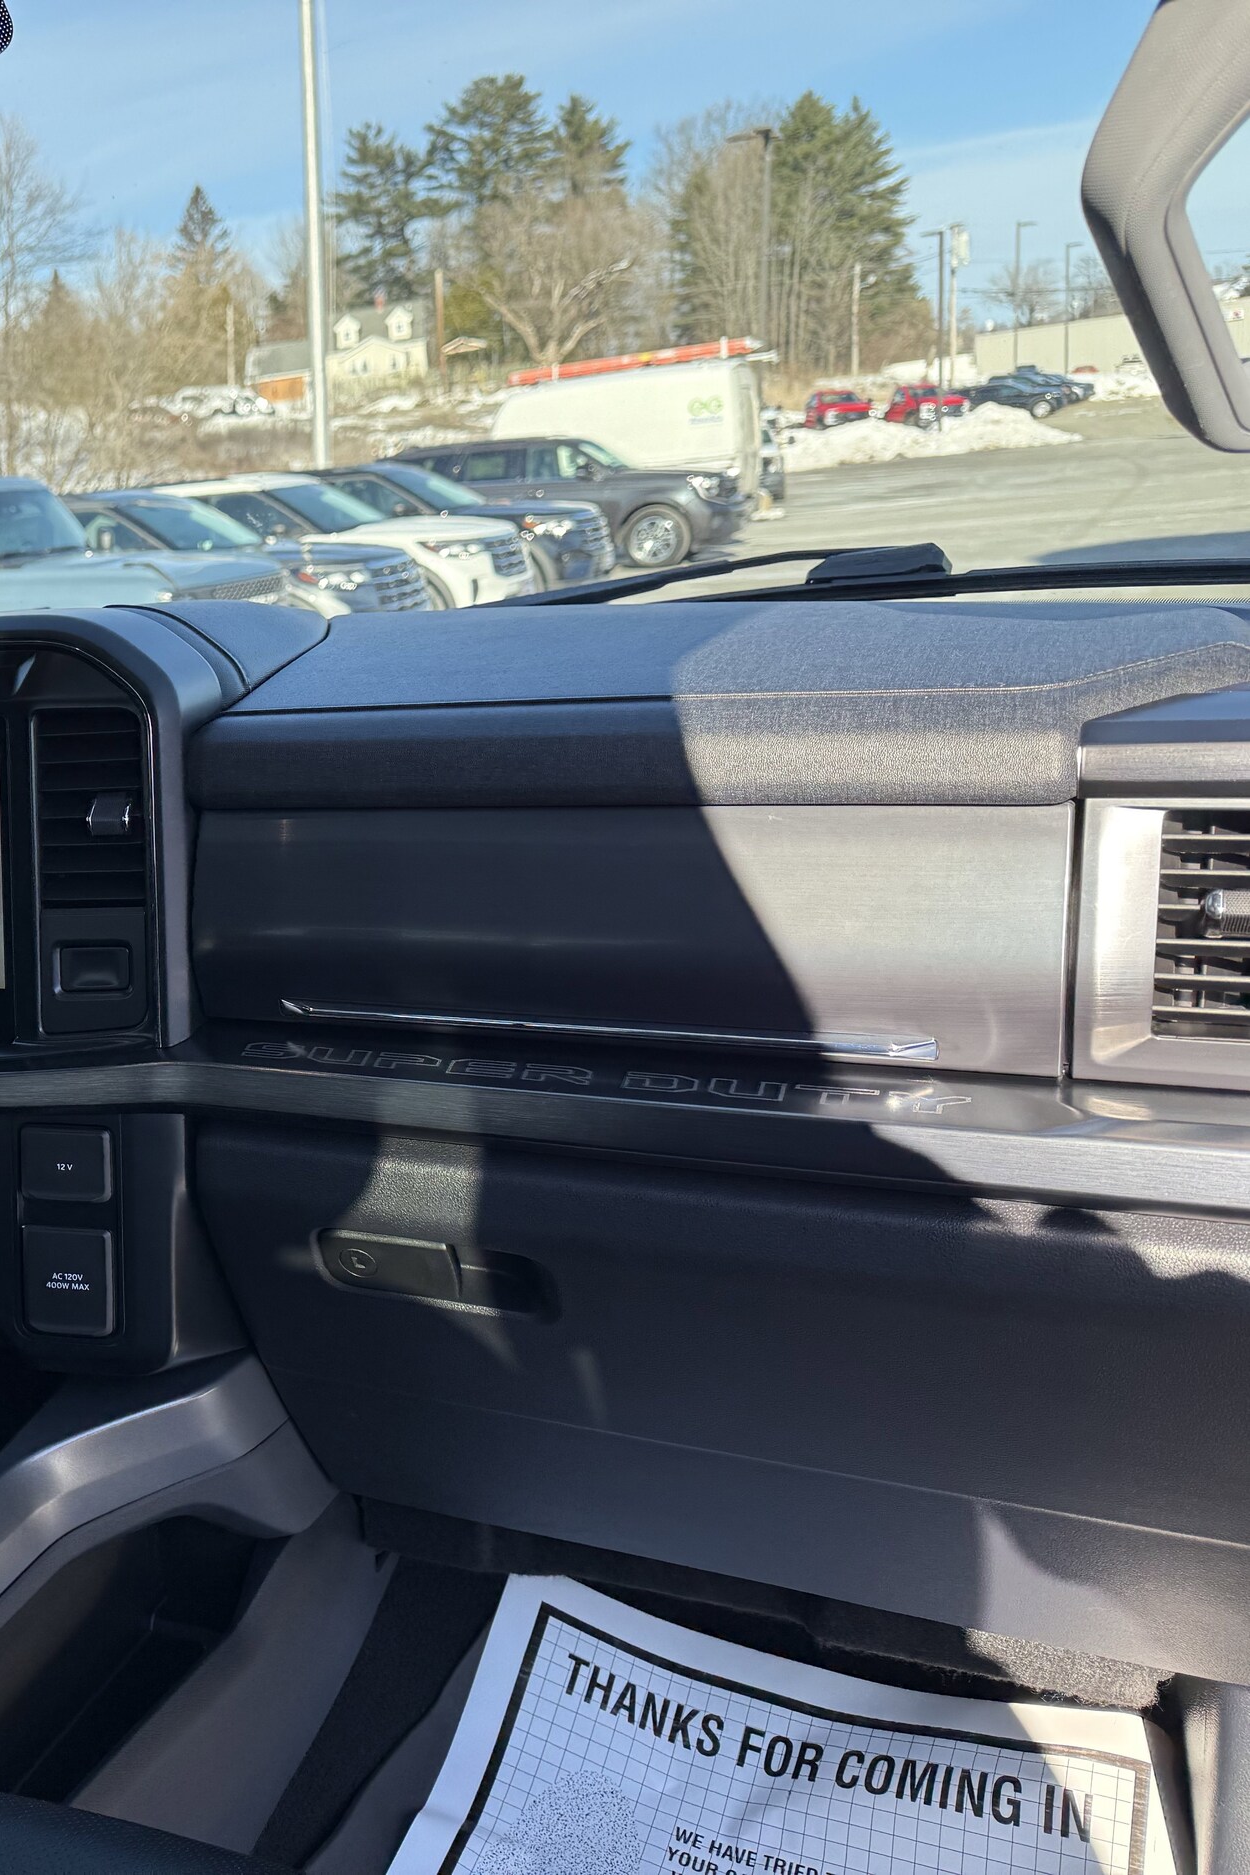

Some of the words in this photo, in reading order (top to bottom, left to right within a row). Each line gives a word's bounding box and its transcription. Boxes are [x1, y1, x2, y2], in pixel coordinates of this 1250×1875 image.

[240, 1041, 593, 1087] SUPER
[619, 1070, 973, 1115] DUTY
[56, 1163, 66, 1171] 12
[66, 1163, 73, 1171] V
[45, 1281, 70, 1290] 400W
[71, 1282, 90, 1291] MAX
[51, 1272, 63, 1280] AC
[64, 1273, 84, 1282] 120V
[564, 1653, 725, 1757] THANKS
[736, 1726, 822, 1781] FOR
[835, 1748, 1022, 1827] COMING
[1043, 1784, 1093, 1842] IN
[667, 1846, 719, 1875] YOUR
[675, 1826, 705, 1849] WE
[708, 1839, 758, 1868] HAVE
